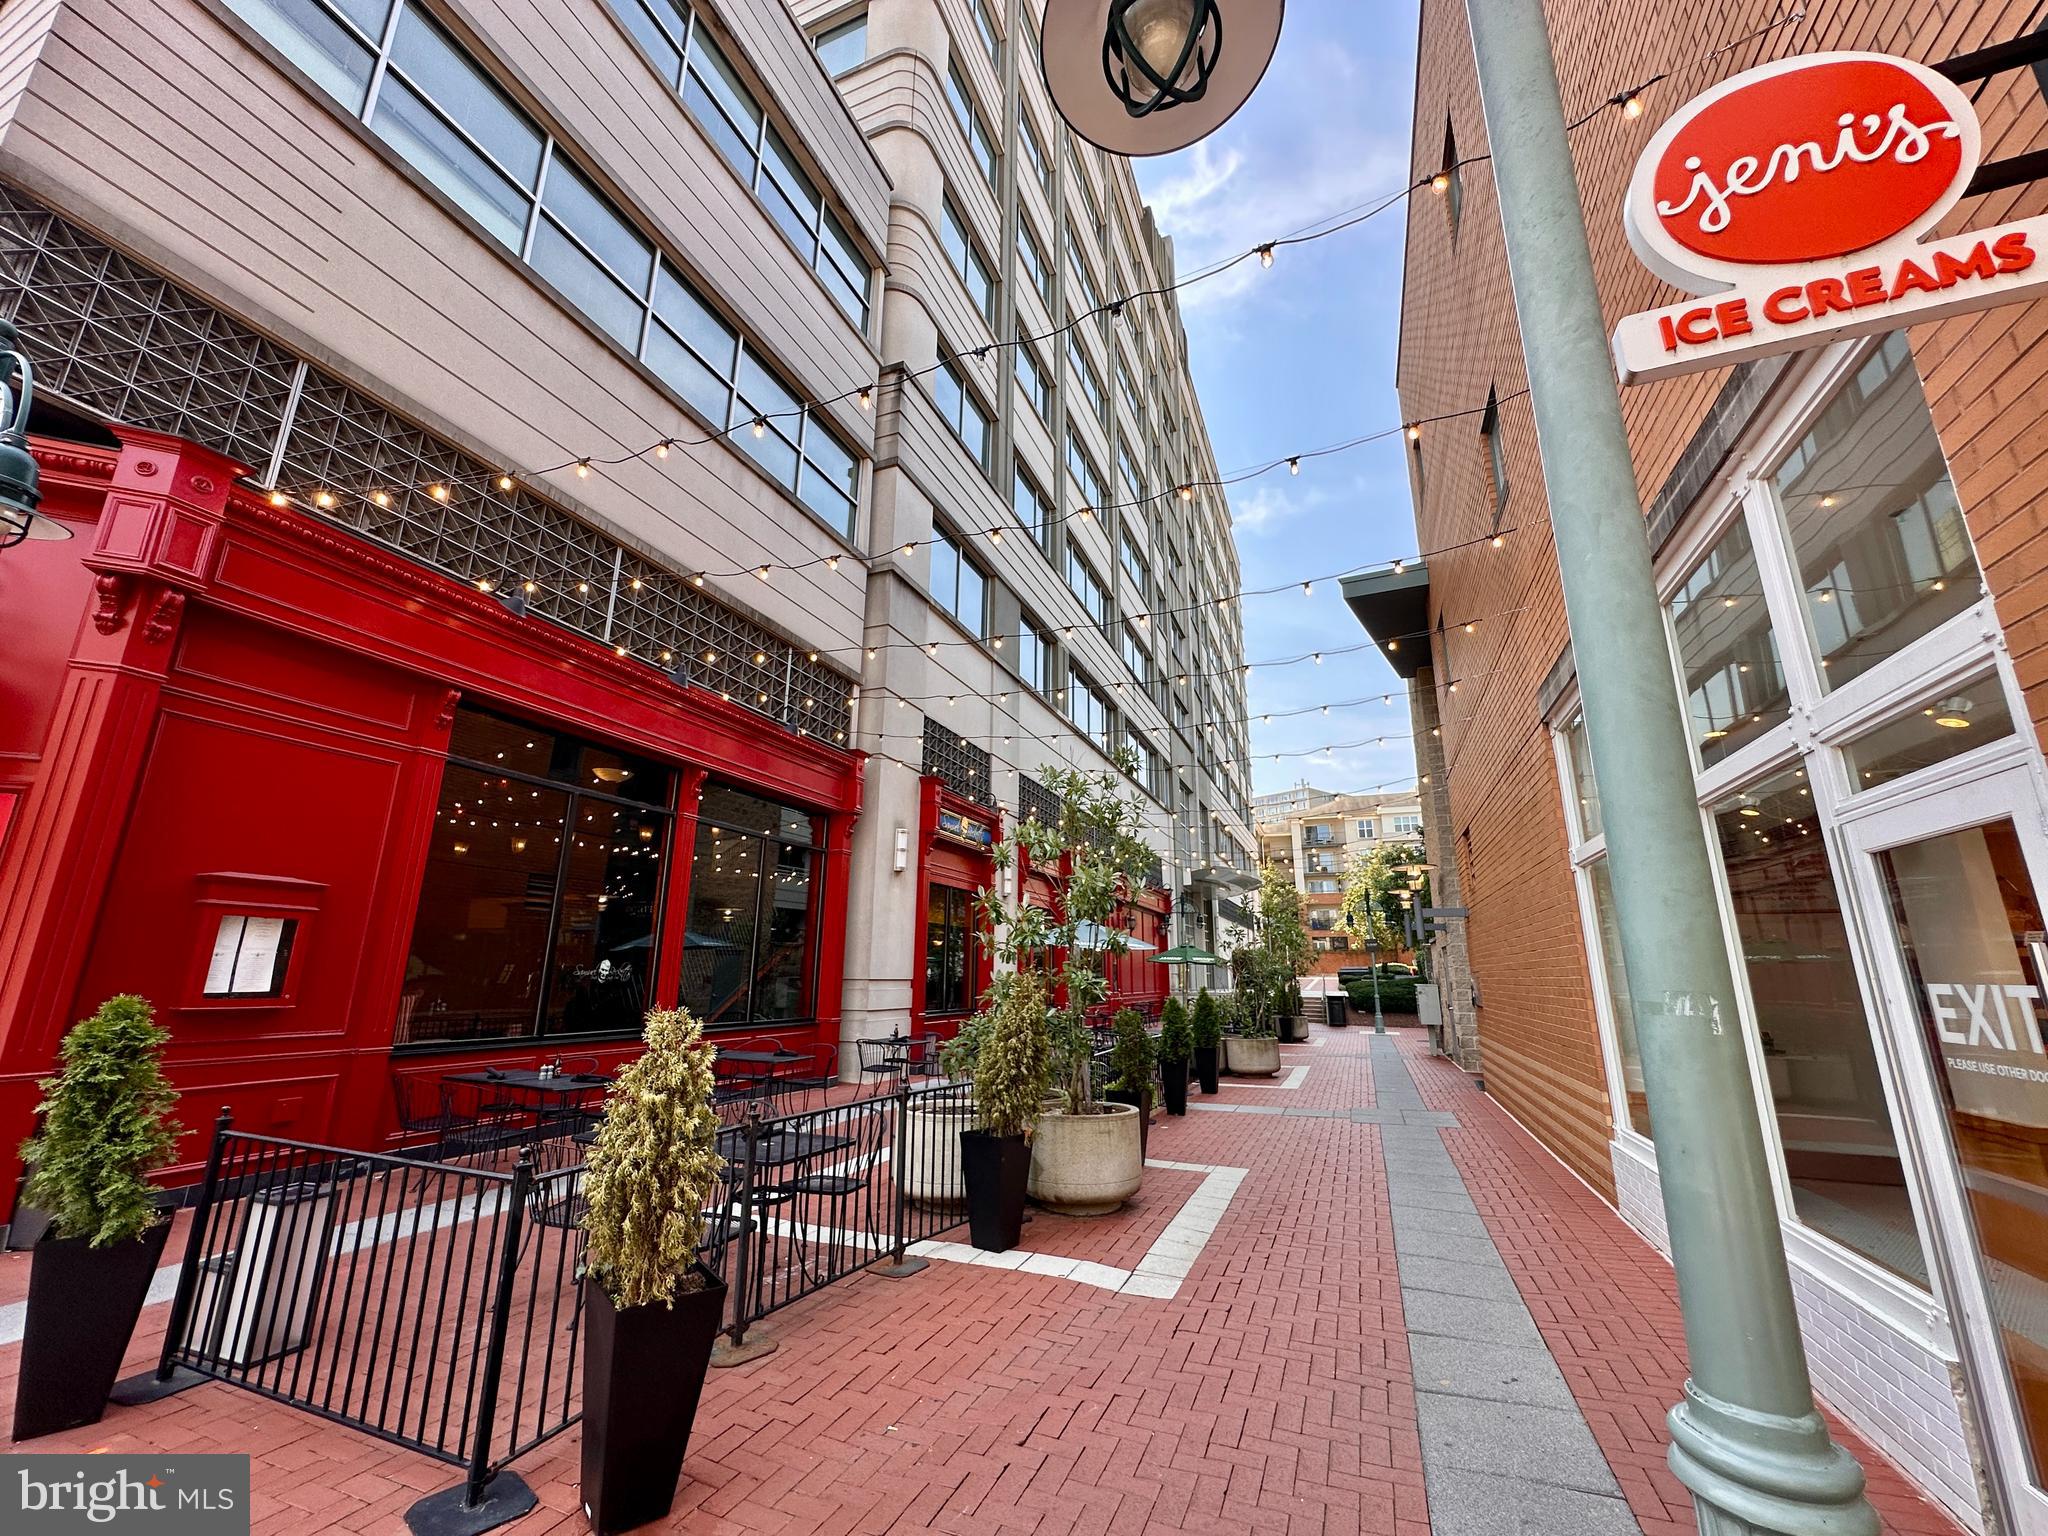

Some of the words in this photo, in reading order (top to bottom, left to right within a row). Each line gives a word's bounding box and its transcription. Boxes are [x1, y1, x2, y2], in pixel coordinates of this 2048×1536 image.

[1656, 103, 1961, 234] jeni's
[1658, 298, 1753, 352] ICE
[1762, 231, 2037, 325] CREAMS
[1926, 983, 2044, 1055] EXIT
[1947, 1057, 1979, 1072] PLEASE
[1978, 1062, 1998, 1075] USE
[1997, 1064, 2029, 1080] OTHER
